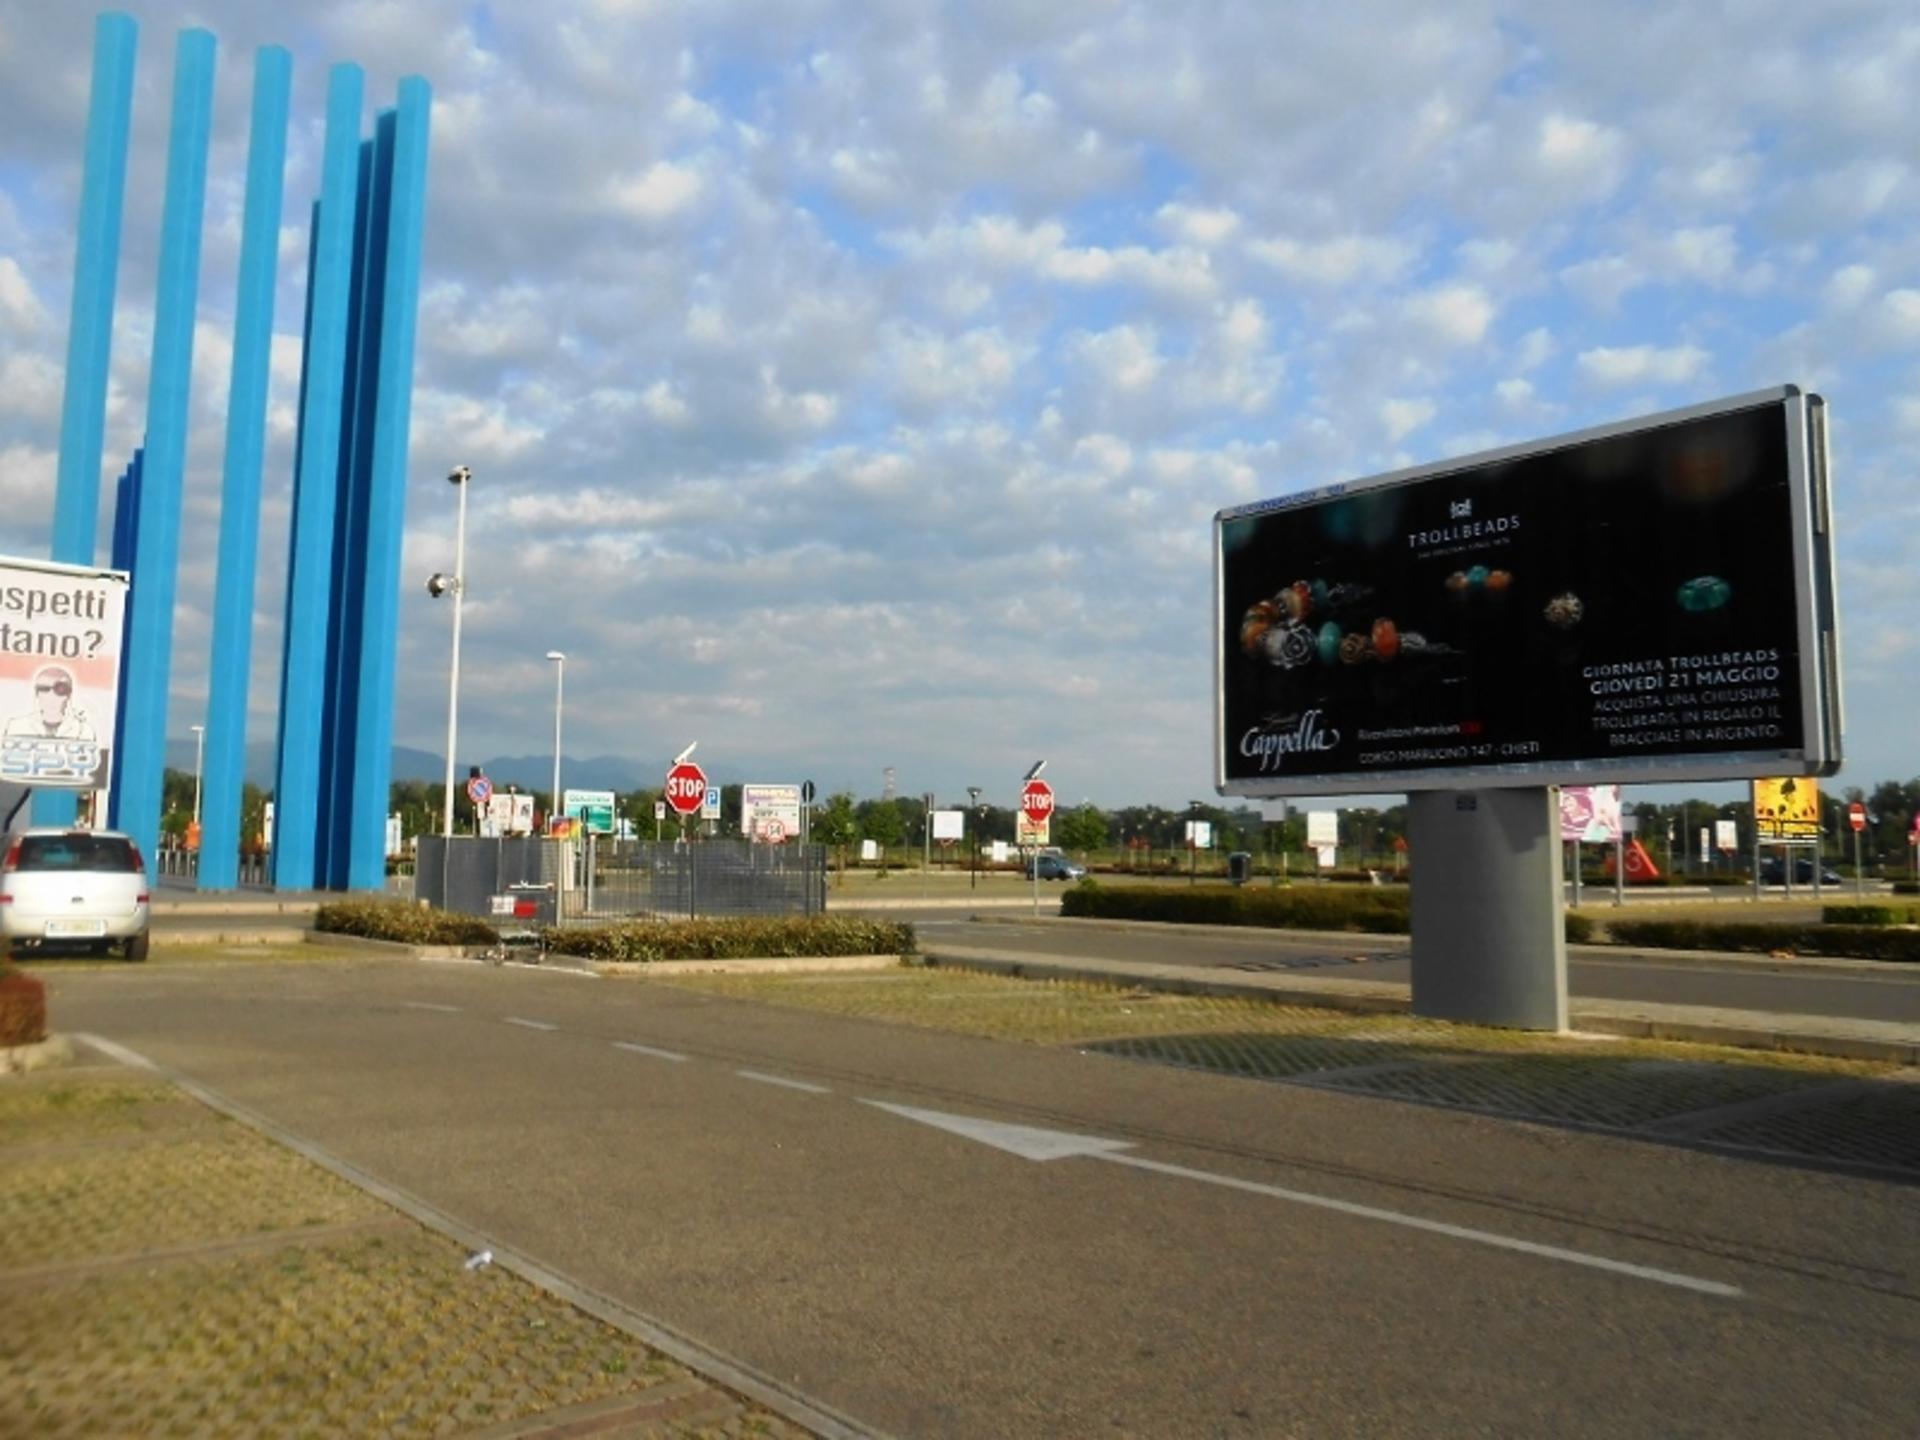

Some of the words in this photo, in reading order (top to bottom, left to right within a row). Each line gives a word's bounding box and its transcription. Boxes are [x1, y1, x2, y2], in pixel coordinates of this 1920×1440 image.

[1408, 515, 1520, 548] TROLLBEADS
[1583, 660, 1664, 678] GIORNATA
[1670, 649, 1779, 669] TROLLBEADS
[1669, 674, 1690, 687] 21
[1697, 666, 1780, 685] MAGGIO
[1594, 695, 1662, 712] ACQUISTA
[1665, 694, 1698, 706] UNA
[1701, 687, 1780, 704] CHIUSURA
[1682, 710, 1700, 723] IN
[1703, 706, 1764, 721] REGALO
[1768, 706, 1782, 719] IL
[1240, 709, 1340, 771] Cappella
[1610, 729, 1680, 746] BRACCIALE
[1685, 728, 1701, 741] IN
[1359, 751, 1398, 764] CORSO
[669, 777, 704, 798] STOP
[1023, 793, 1050, 810] STOP
